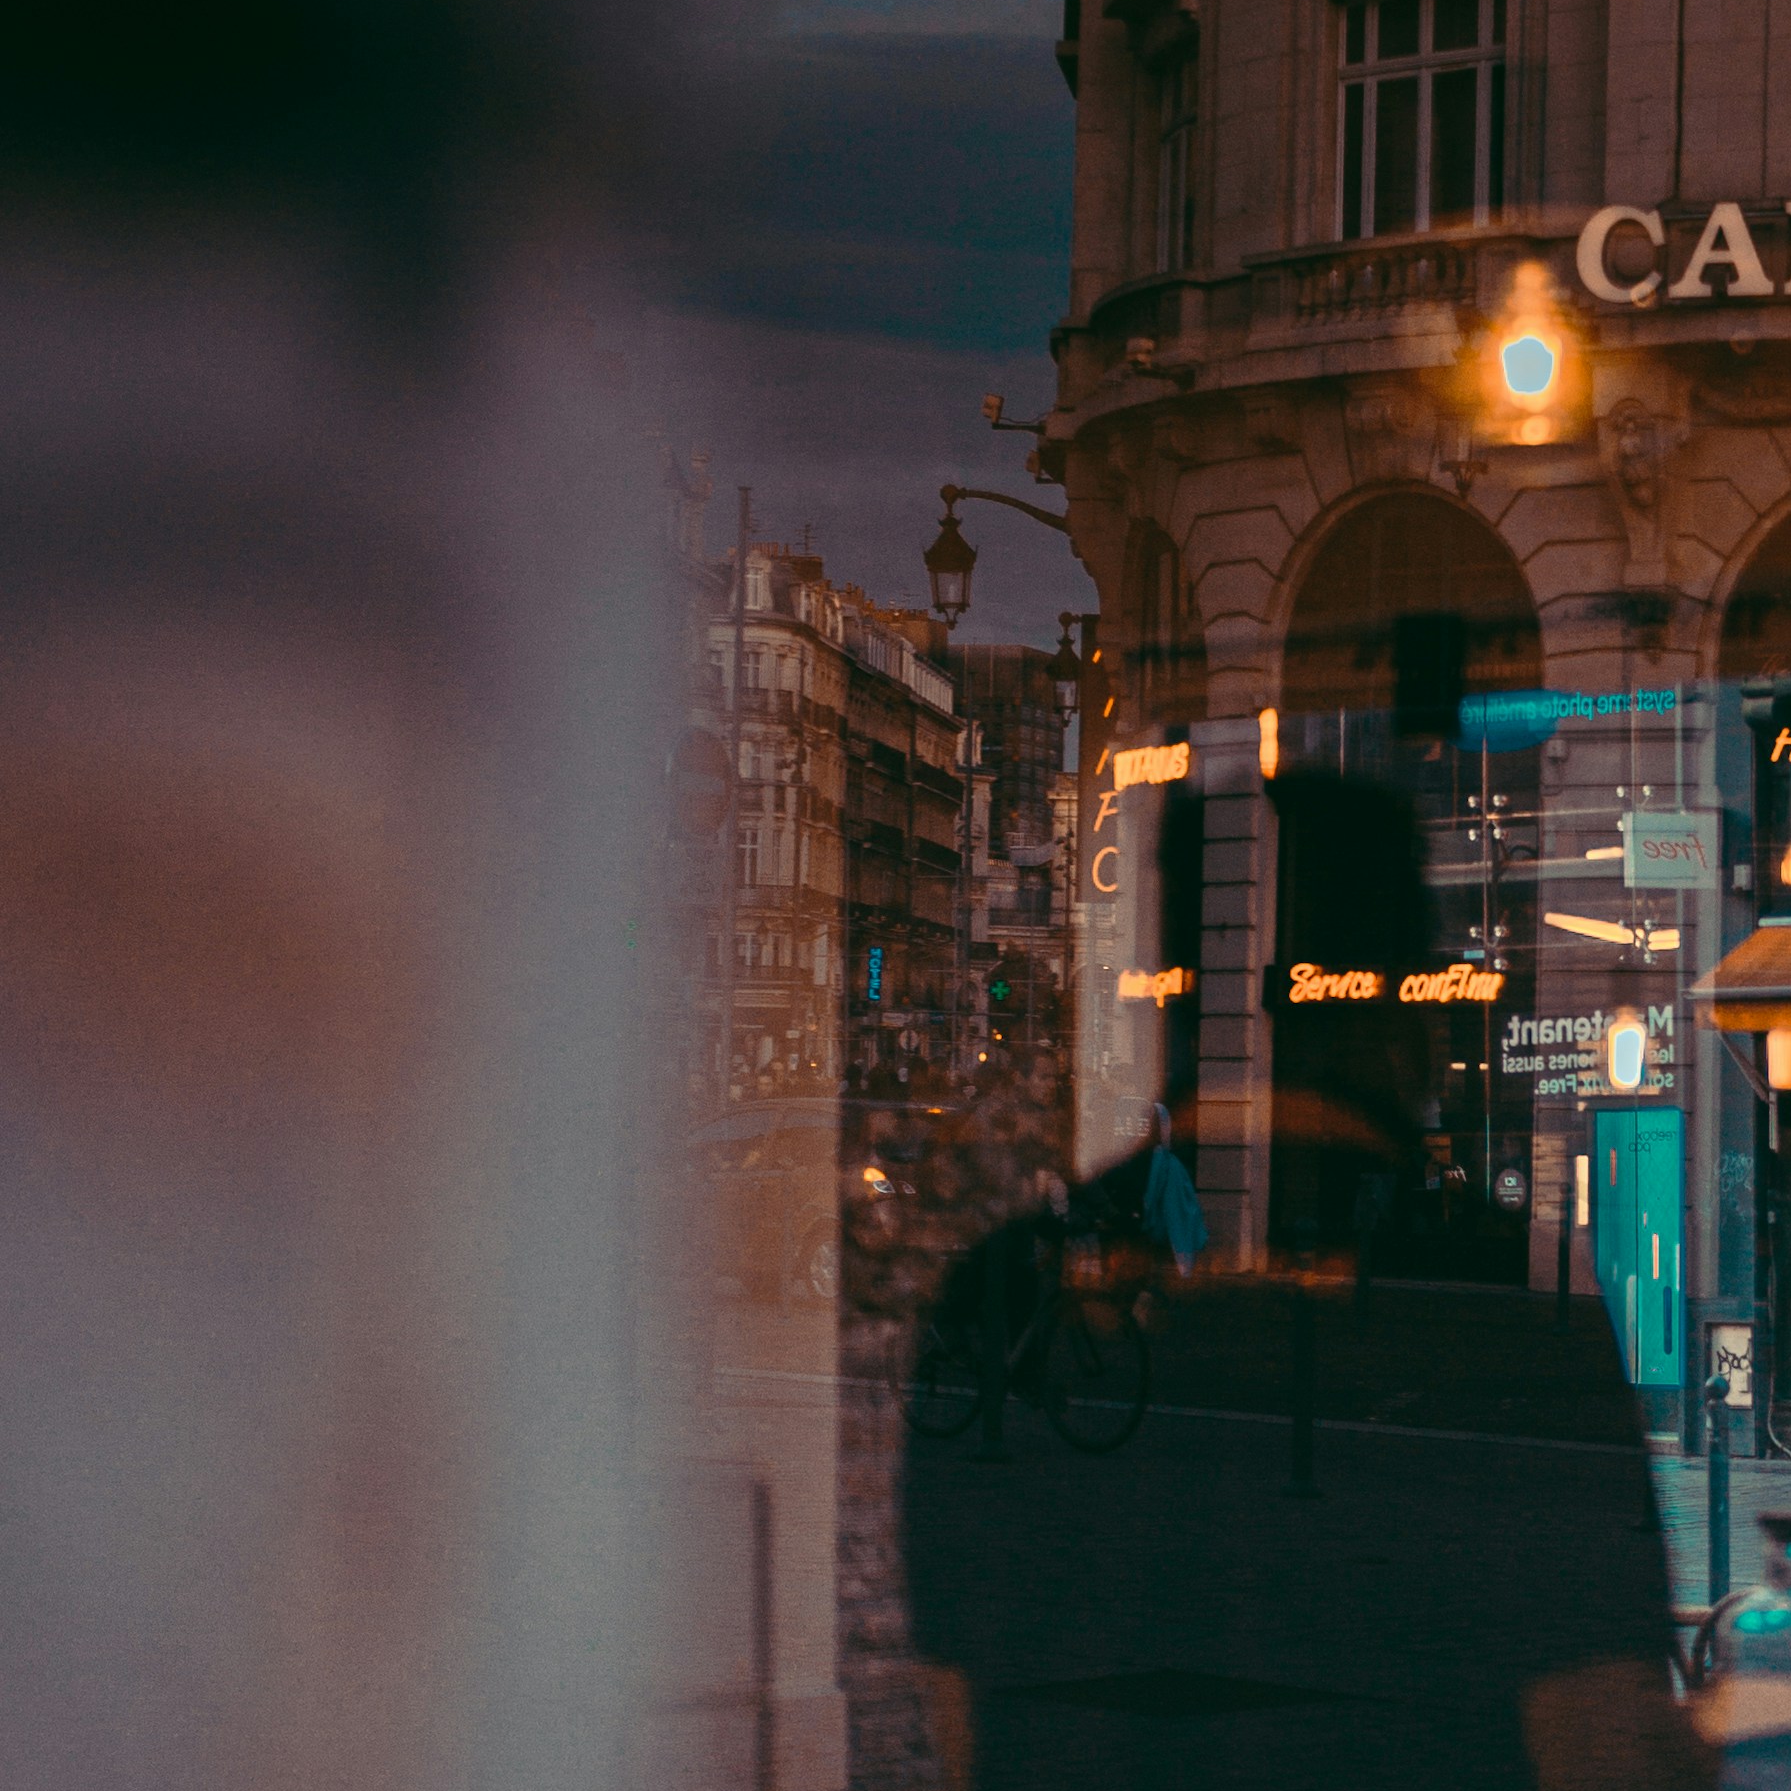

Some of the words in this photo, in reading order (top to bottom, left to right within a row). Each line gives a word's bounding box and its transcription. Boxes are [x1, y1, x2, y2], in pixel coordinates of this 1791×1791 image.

[868, 947, 882, 1000] HOTEL
[1288, 962, 1380, 1003] Service
[1398, 962, 1505, 1004] continu
